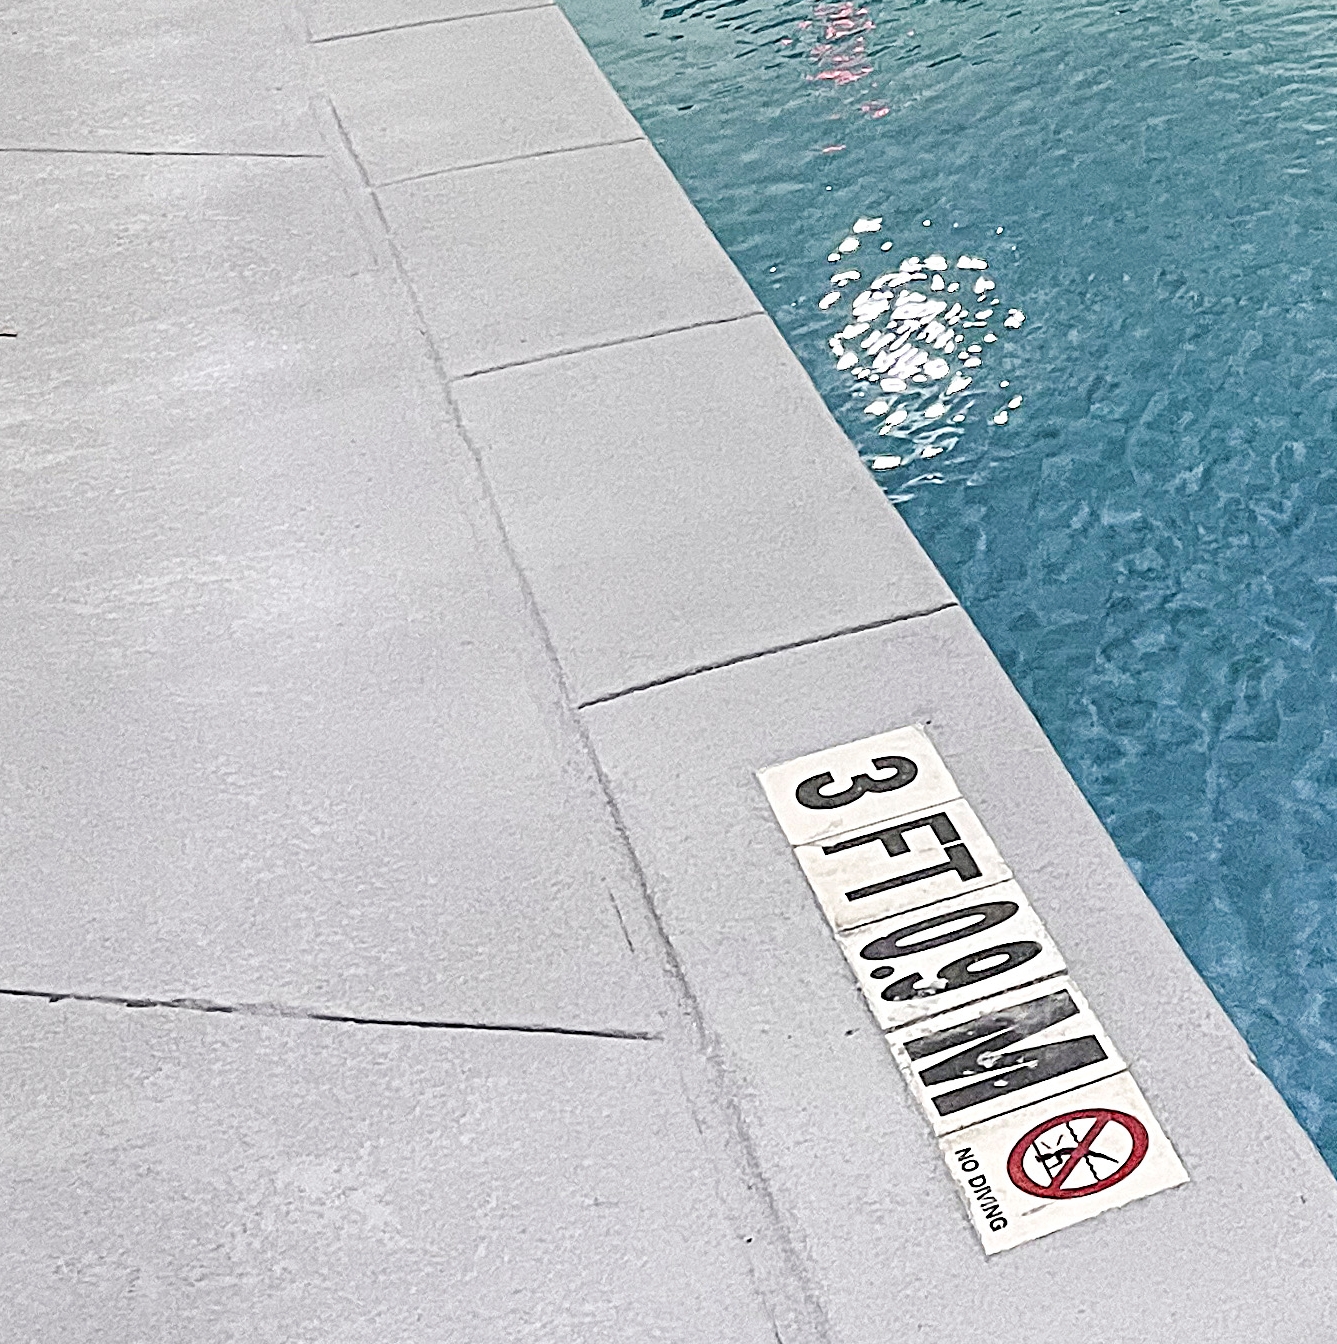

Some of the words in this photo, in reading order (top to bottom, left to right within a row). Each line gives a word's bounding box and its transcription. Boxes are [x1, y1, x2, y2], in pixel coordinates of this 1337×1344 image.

[795, 754, 919, 810] 3
[821, 811, 983, 903] FT
[902, 988, 1109, 1117] M
[954, 1147, 979, 1173] NO
[968, 1174, 1008, 1232] DIVING
